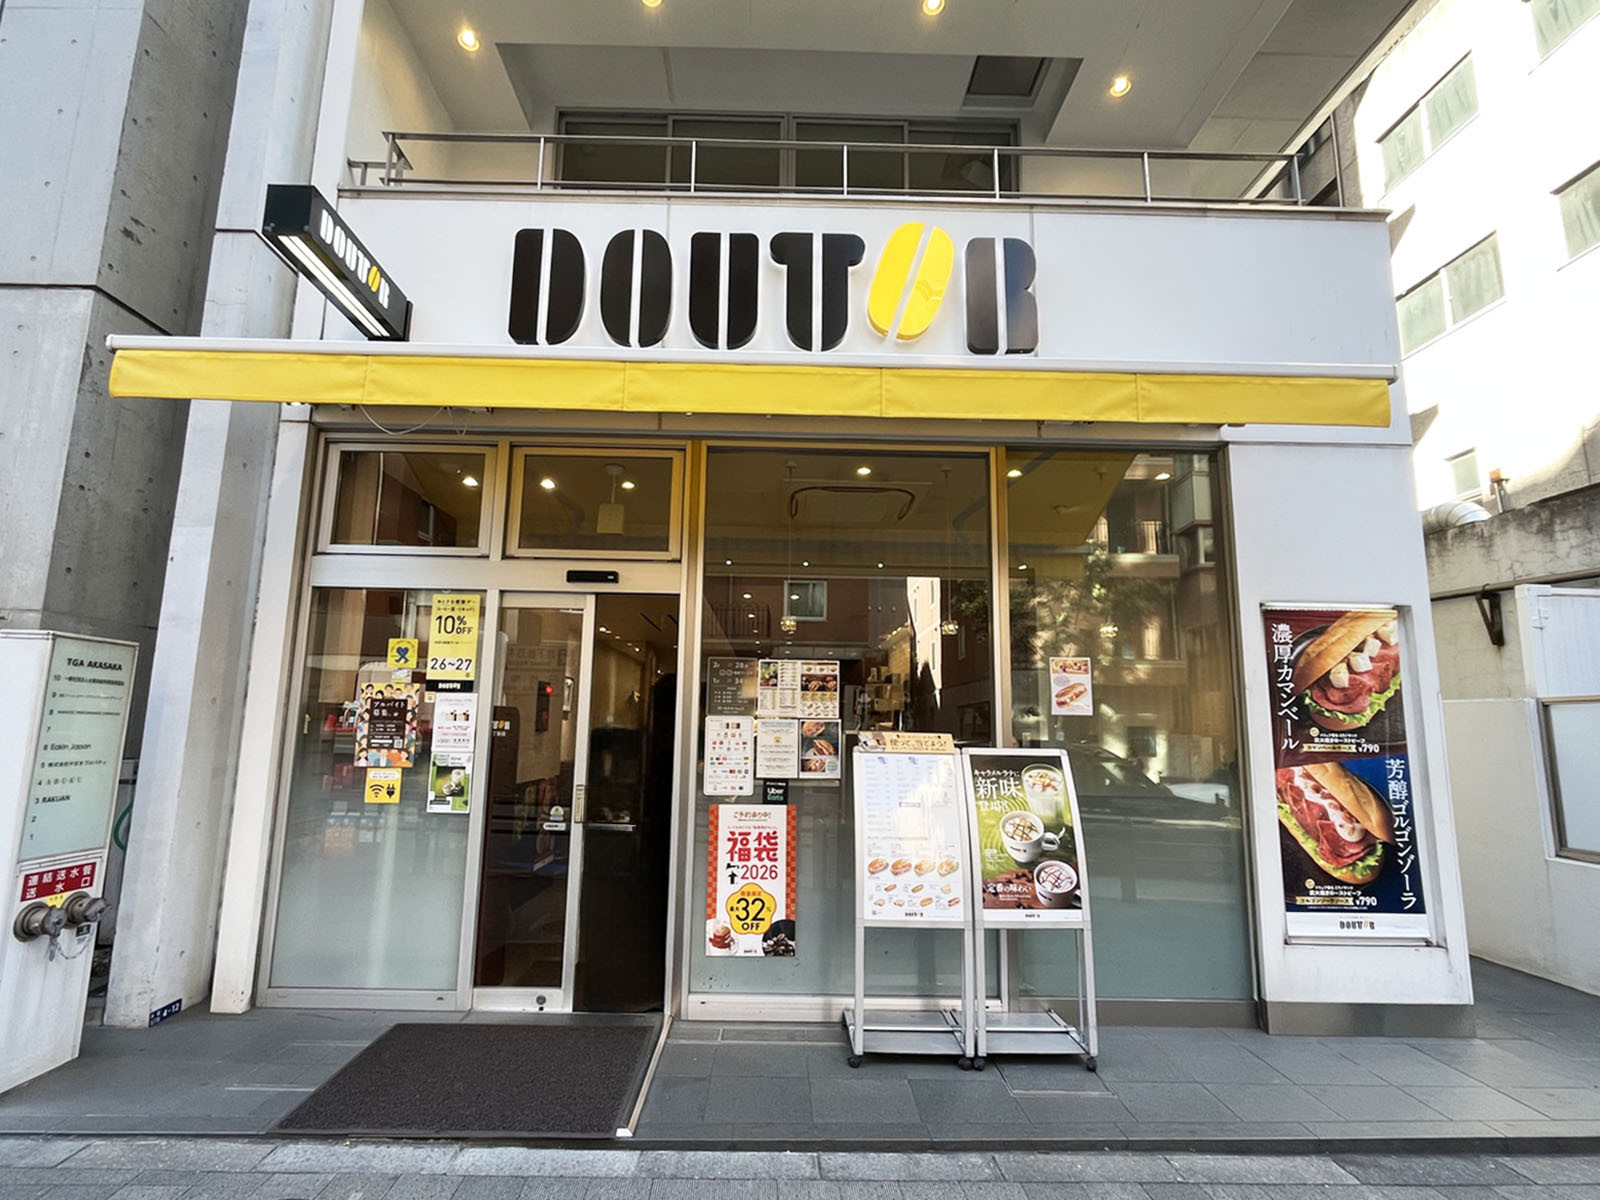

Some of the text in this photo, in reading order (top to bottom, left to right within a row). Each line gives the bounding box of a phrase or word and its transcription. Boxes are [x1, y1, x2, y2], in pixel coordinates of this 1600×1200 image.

[320, 209, 390, 309] DOUTOR
[508, 221, 1039, 356] DOUTOR
[435, 615, 473, 635] 10% OFF
[67, 657, 123, 671] TGA AKASAKA
[1272, 623, 1300, 750] 濃厚カマンベール
[975, 776, 1025, 800] 新味
[1385, 758, 1418, 910] 芳醇ゴルゴンゾーラ
[726, 830, 778, 863] 福袋
[28, 864, 92, 887] 連結送水管
[740, 864, 778, 880] 2026
[735, 897, 765, 921] 32
[741, 922, 760, 931] OFF
